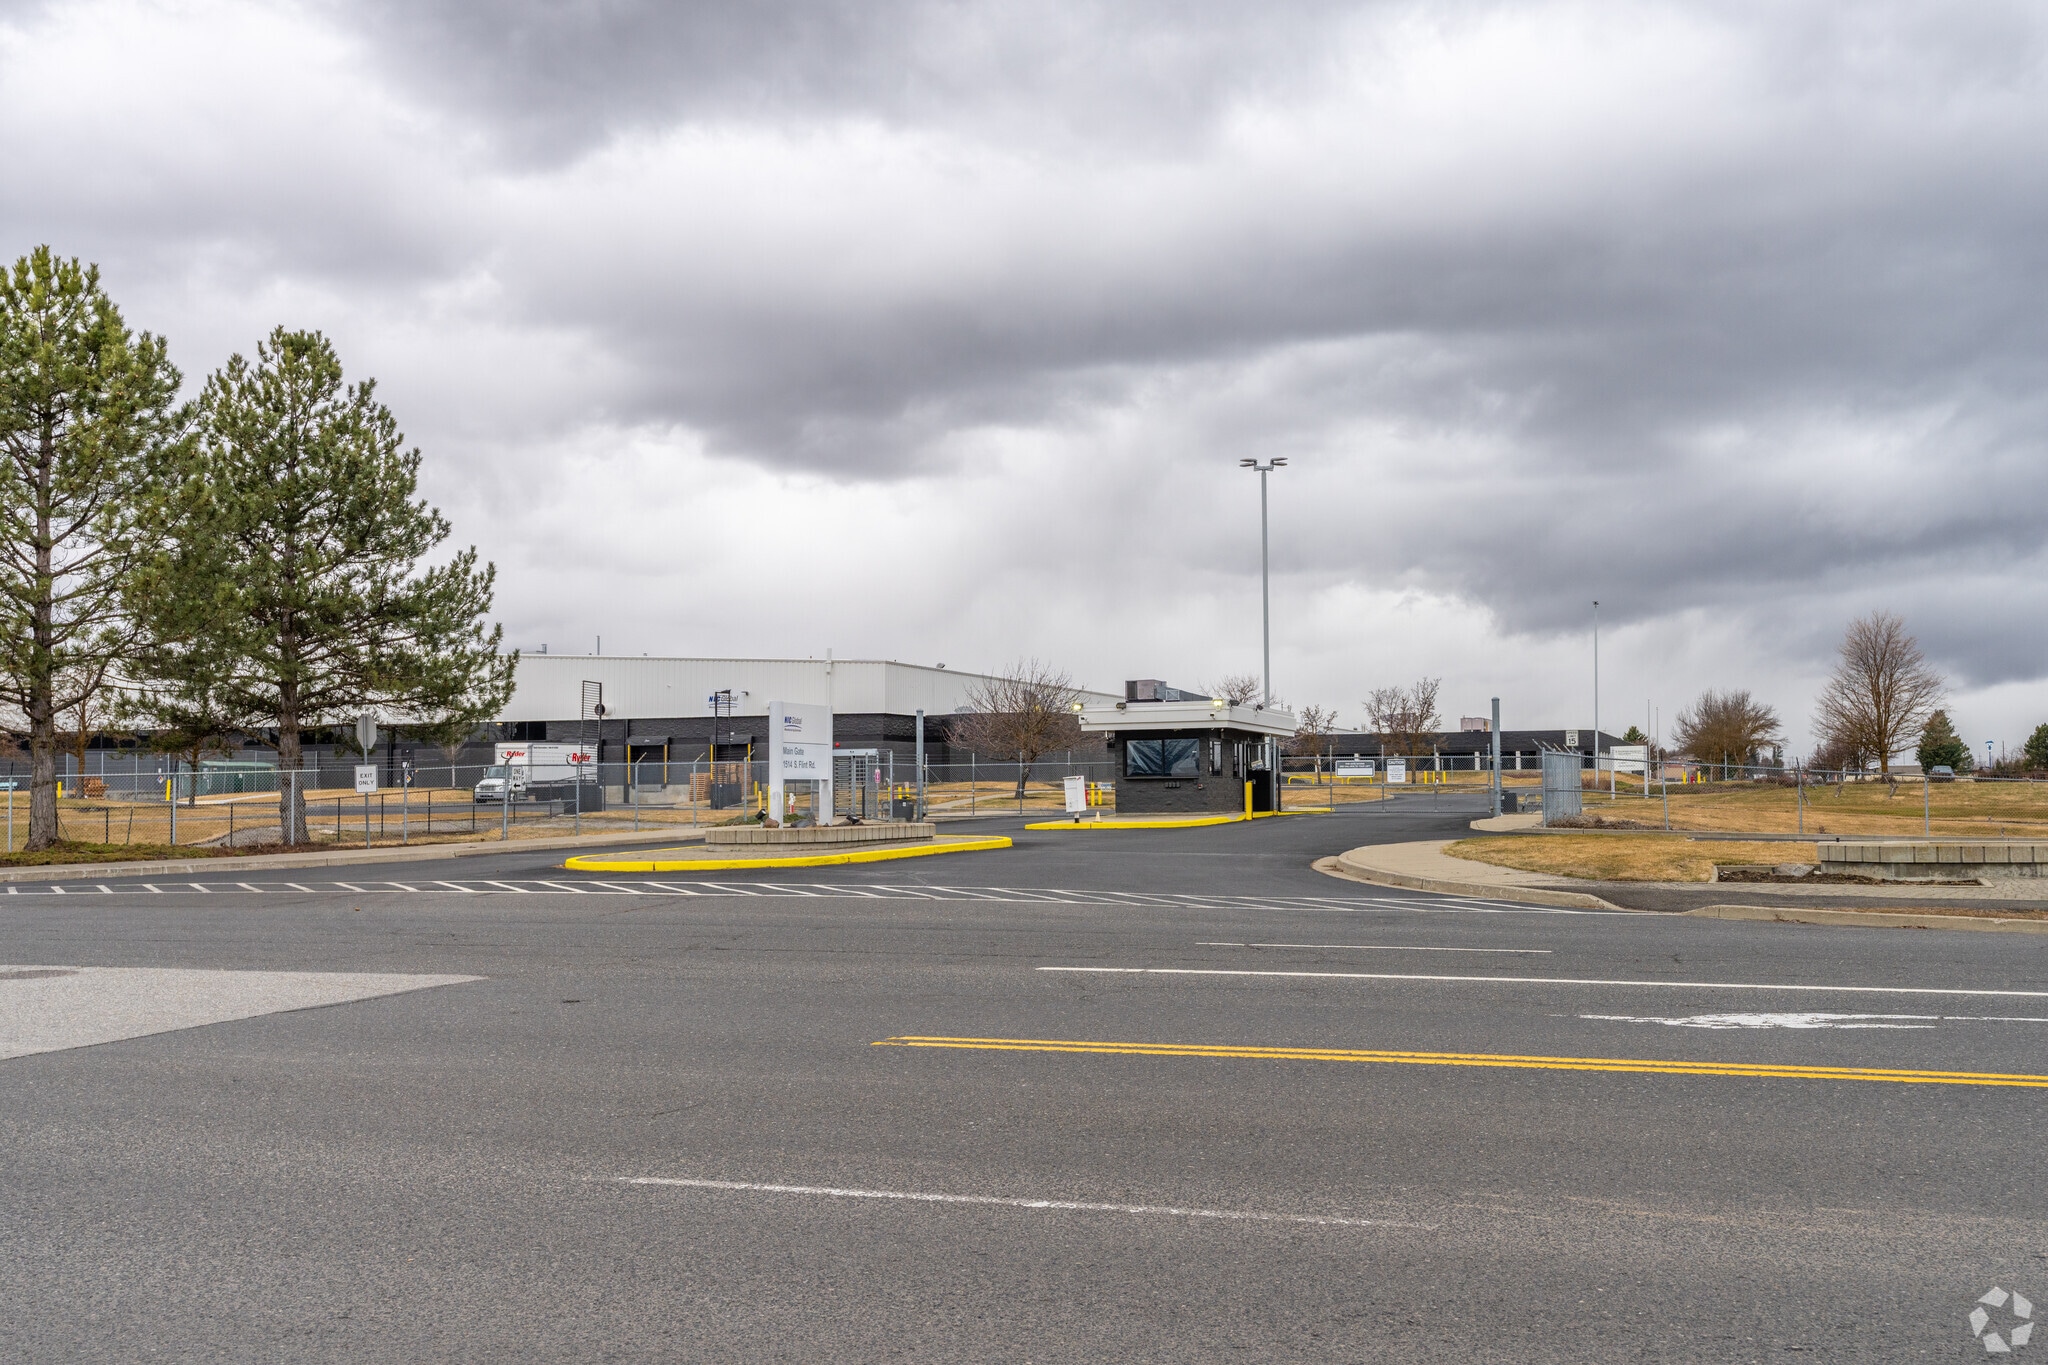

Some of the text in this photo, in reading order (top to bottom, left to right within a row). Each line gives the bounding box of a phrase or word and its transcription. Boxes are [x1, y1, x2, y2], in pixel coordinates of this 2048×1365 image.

[783, 747, 804, 755] Main Gate
[799, 761, 808, 769] Flint
